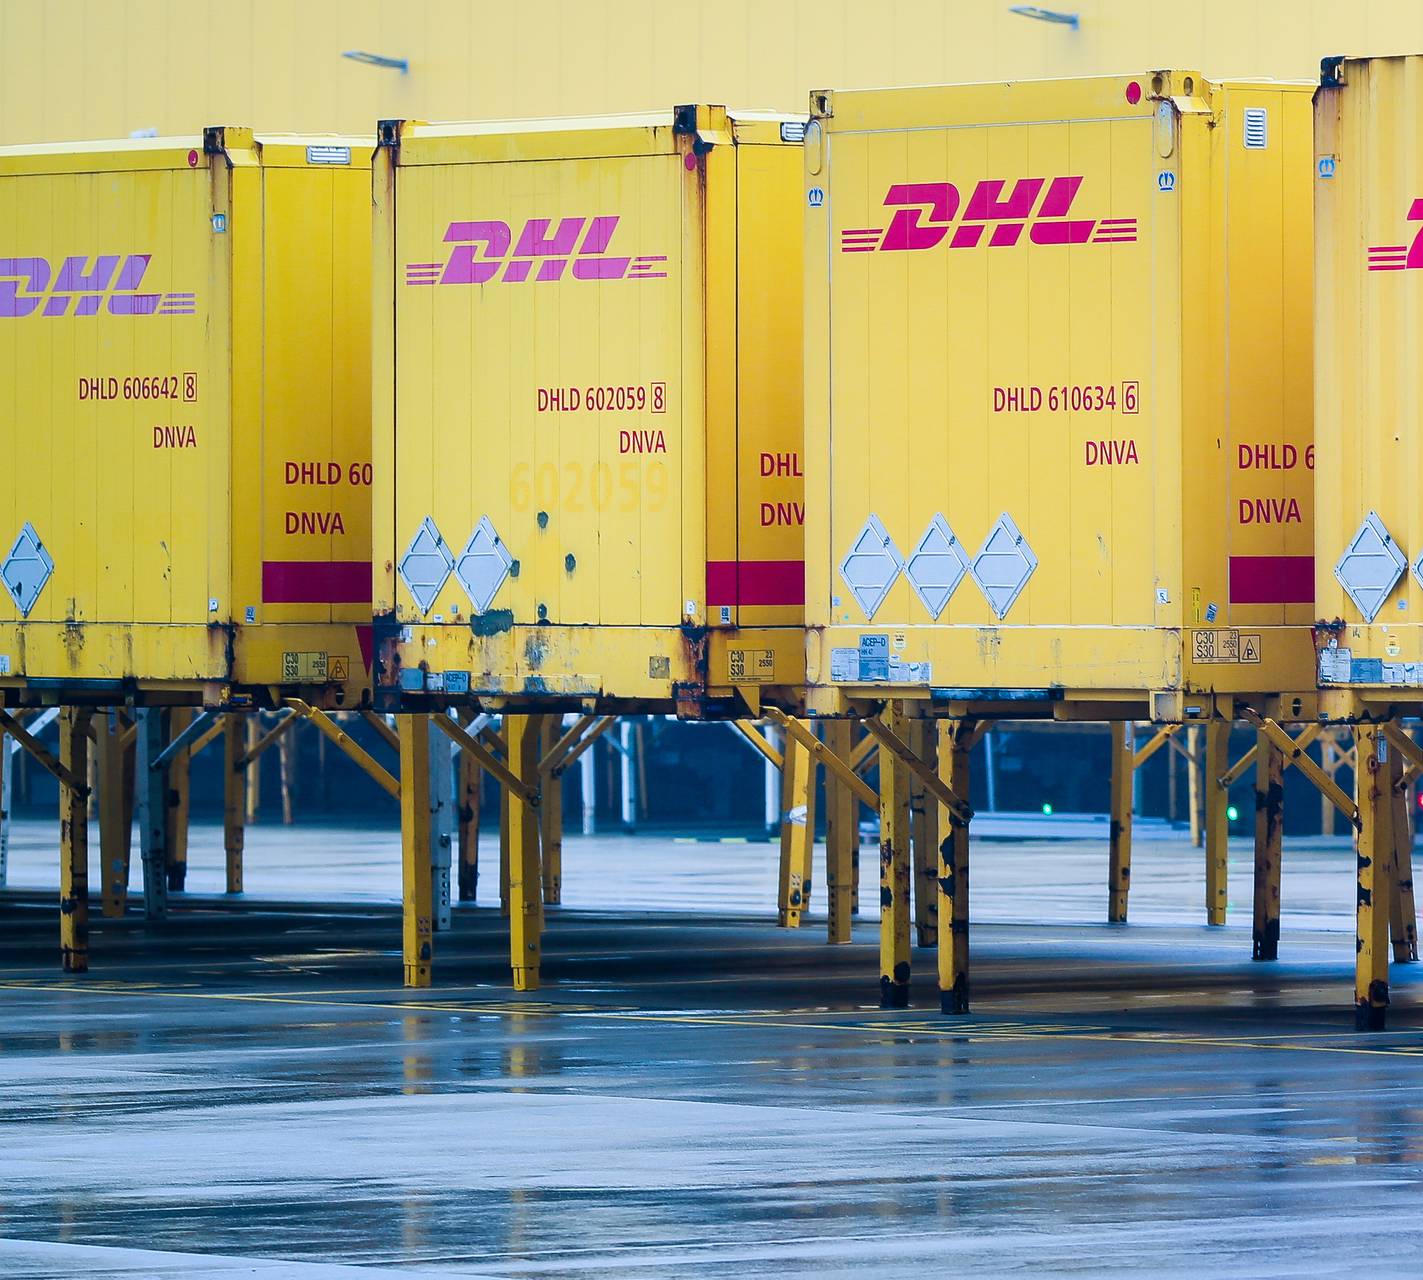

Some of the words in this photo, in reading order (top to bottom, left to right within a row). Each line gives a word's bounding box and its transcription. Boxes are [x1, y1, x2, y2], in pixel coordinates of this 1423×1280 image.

[879, 176, 1097, 251] DHL
[439, 216, 632, 284] DHL
[79, 378, 117, 400] DHLD
[123, 377, 178, 400] 606642
[185, 376, 195, 399] 8
[537, 388, 580, 412] DHLD
[585, 387, 646, 411] 602059
[653, 384, 664, 411] 8
[993, 386, 1042, 412] DHLD
[1048, 385, 1117, 411] 610634
[1124, 384, 1137, 411] 6
[153, 426, 197, 448] DNVA
[619, 430, 667, 453] DNVA
[1085, 439, 1139, 465] DNVA
[1238, 444, 1297, 470] DHLD
[285, 461, 341, 485] DHLD
[348, 462, 373, 486] 60
[285, 511, 345, 535] DNVA
[1238, 497, 1302, 525] DNVA
[1195, 631, 1215, 645] C30
[730, 650, 745, 664] C30
[1196, 645, 1215, 658] S30
[285, 664, 299, 677] S30
[730, 663, 745, 677] S30
